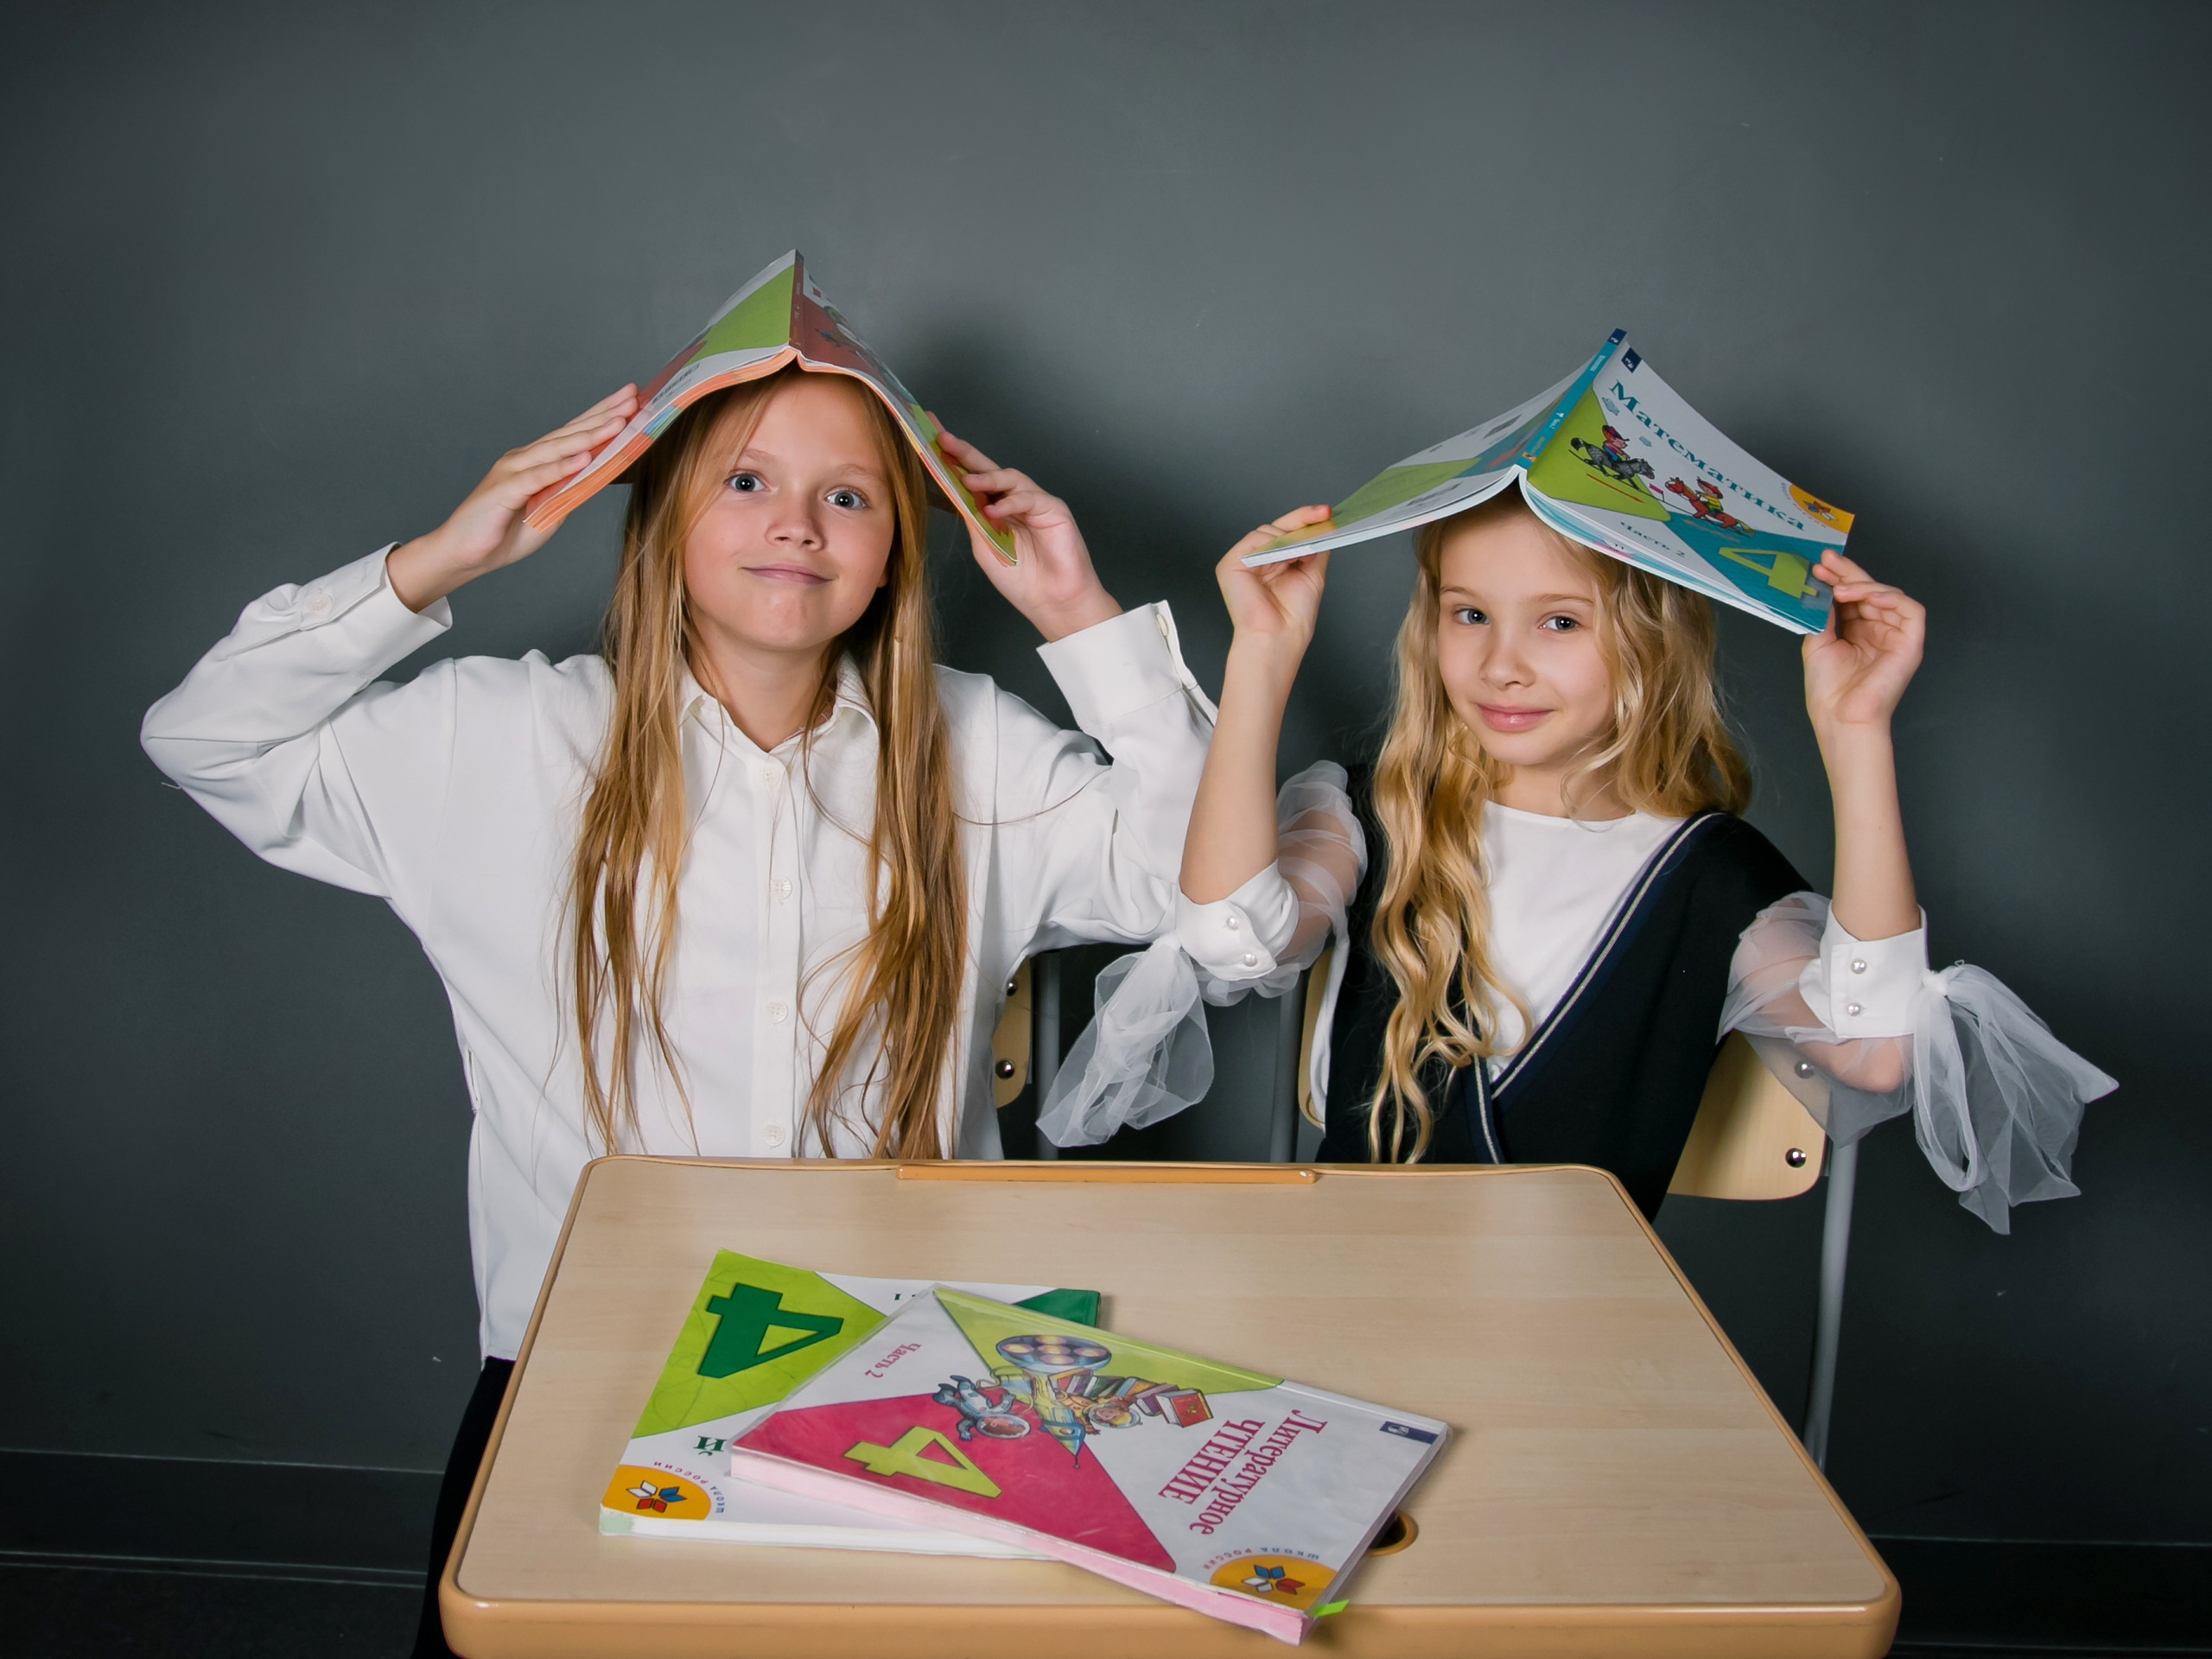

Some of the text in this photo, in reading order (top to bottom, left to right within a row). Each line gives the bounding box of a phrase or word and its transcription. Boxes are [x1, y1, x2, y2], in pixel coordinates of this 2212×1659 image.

[1608, 379, 1804, 531] Математика
[1620, 521, 1670, 550] Часть
[1718, 547, 1817, 599] 4
[696, 1282, 843, 1378] 4
[865, 1344, 922, 1378] Часть 2
[653, 1461, 709, 1484] РОССИИ
[842, 1426, 1002, 1498] 4
[1158, 1419, 1265, 1504] ЧТЕНИЕ
[1189, 1409, 1327, 1535] Литературное
